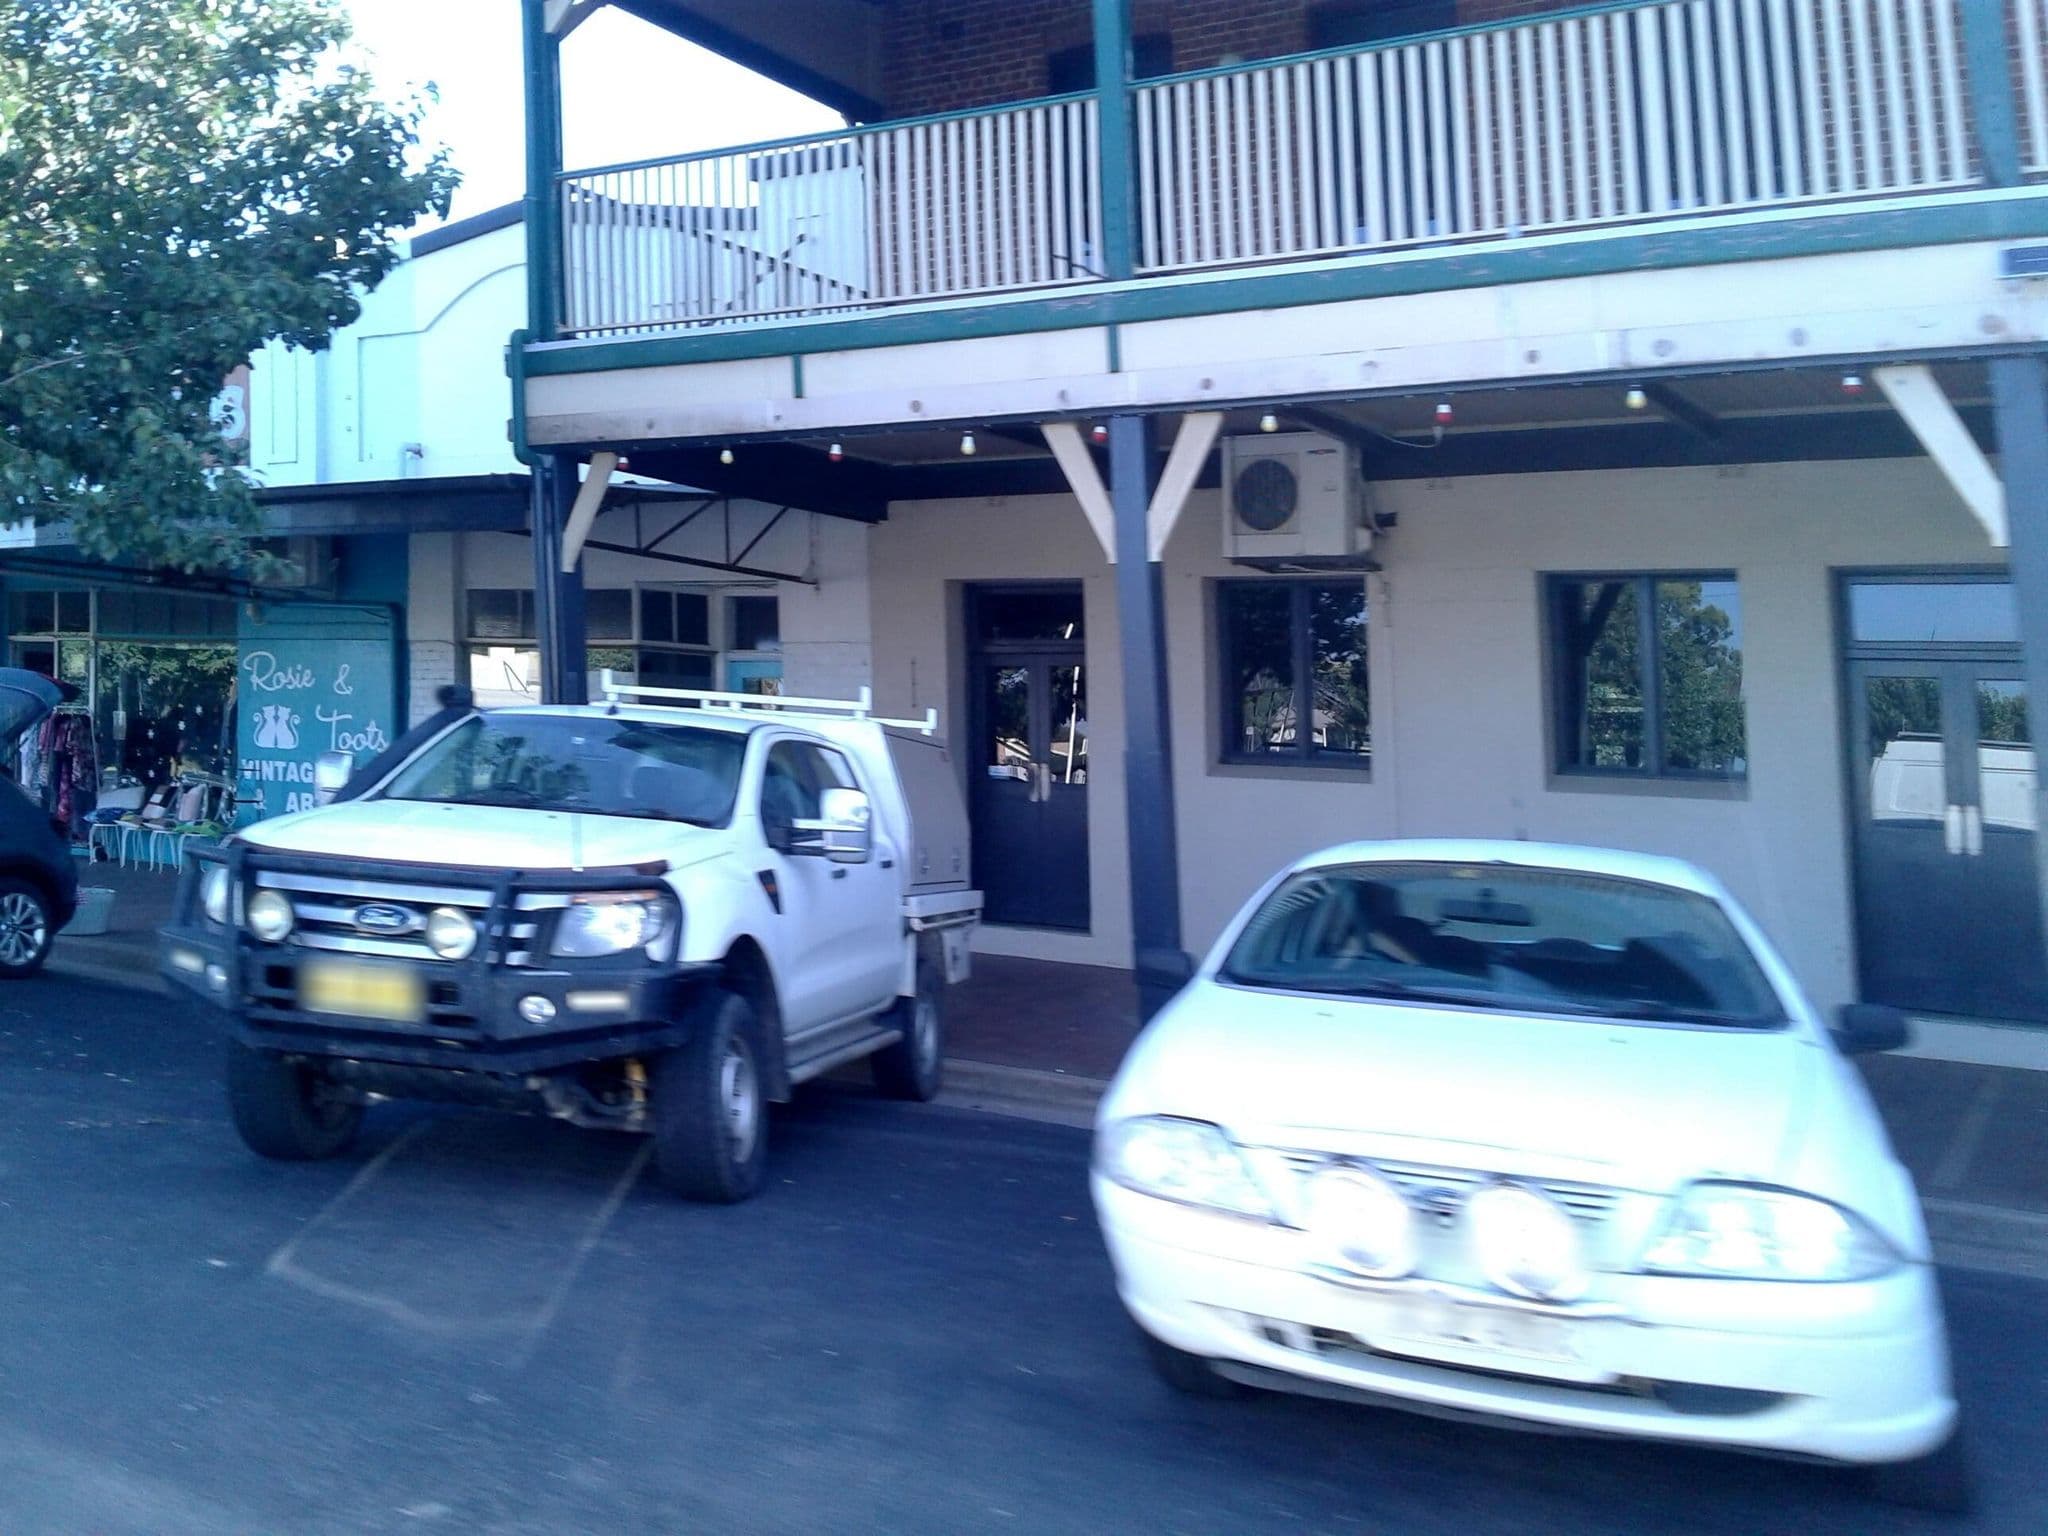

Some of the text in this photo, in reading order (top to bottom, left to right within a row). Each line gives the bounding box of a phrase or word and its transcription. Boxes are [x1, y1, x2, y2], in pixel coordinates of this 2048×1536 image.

[243, 650, 354, 695] Rosie &
[315, 703, 390, 754] Toots
[241, 759, 315, 784] VINTAG
